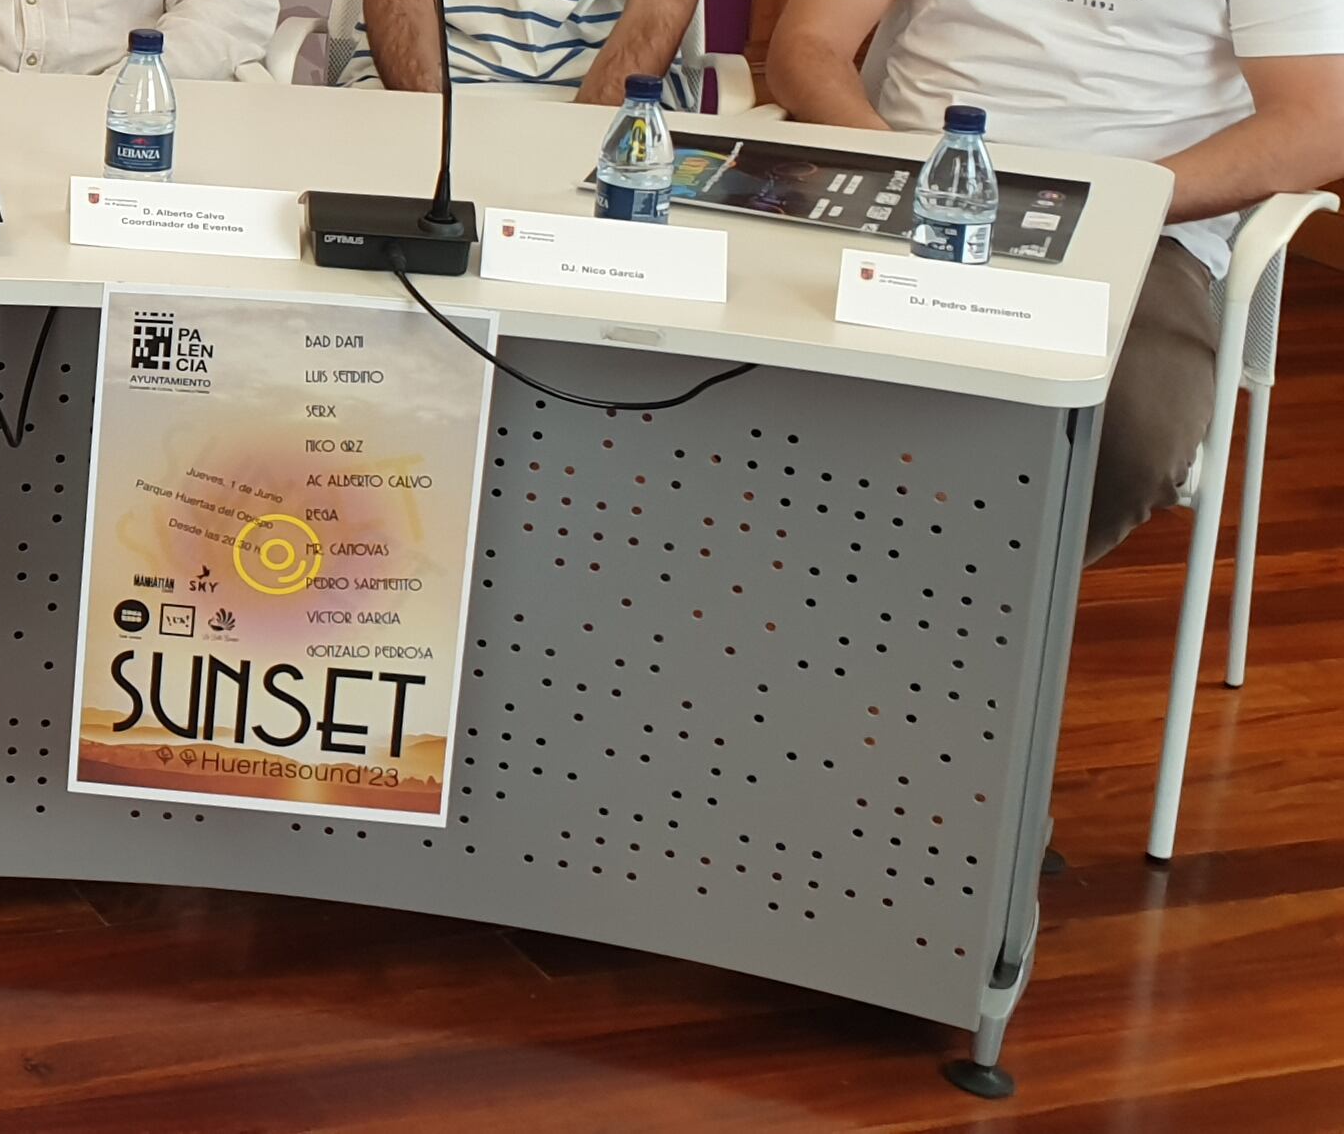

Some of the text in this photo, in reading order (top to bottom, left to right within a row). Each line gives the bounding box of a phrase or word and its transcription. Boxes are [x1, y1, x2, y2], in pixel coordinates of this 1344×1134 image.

[117, 146, 160, 159] LEBANZA
[143, 208, 225, 221] D. Alberto Calvo
[121, 217, 244, 233] Coordinador de Eventos
[561, 263, 578, 272] DJ.
[581, 266, 606, 275] Nico
[909, 296, 1032, 320] DJ. Pedro Sarmiento
[178, 328, 202, 342] PA
[305, 335, 364, 348] BAD DANI
[177, 343, 214, 358] LEN
[175, 358, 208, 373] CIA
[130, 374, 211, 388] AYUNTAMIENTO
[305, 370, 384, 384] LUIS SENDINO
[305, 405, 336, 418] SERX
[305, 440, 335, 453] NICO
[306, 474, 433, 489] AC ALBERTO CALVO
[135, 478, 235, 517] Parque Huertas del
[238, 482, 252, 496] de
[254, 485, 283, 504] Junio
[305, 508, 339, 521] REGA
[168, 517, 220, 542] Desde las
[330, 543, 390, 557] CANOVAS
[189, 580, 221, 593] SKY
[305, 577, 422, 592] PEDRO SARMIENTO
[306, 644, 433, 660] GONZALO PEDROSA
[111, 649, 426, 758] SUNSET
[201, 750, 399, 788] Huertasound'23
